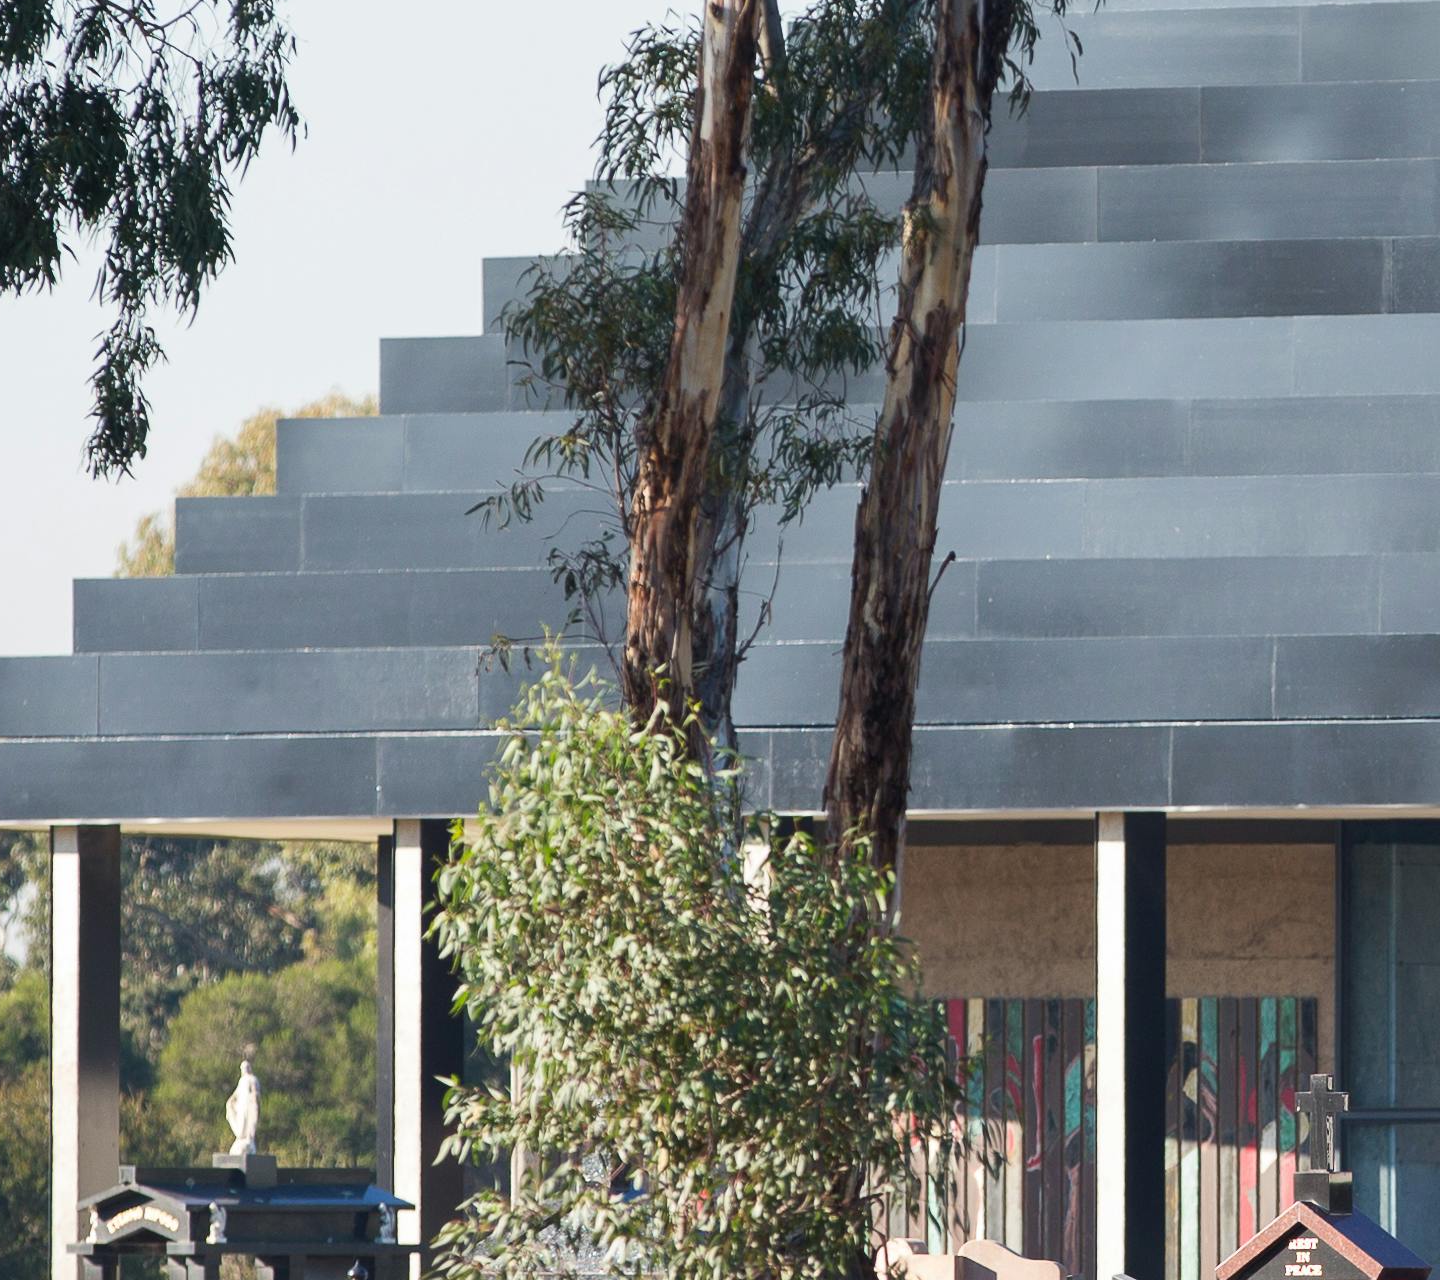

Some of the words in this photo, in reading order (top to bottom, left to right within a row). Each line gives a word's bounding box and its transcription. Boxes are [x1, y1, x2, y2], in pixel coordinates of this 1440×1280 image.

[1288, 1238, 1318, 1250] REST
[1296, 1252, 1310, 1262] IN
[1285, 1264, 1322, 1276] PEACE
